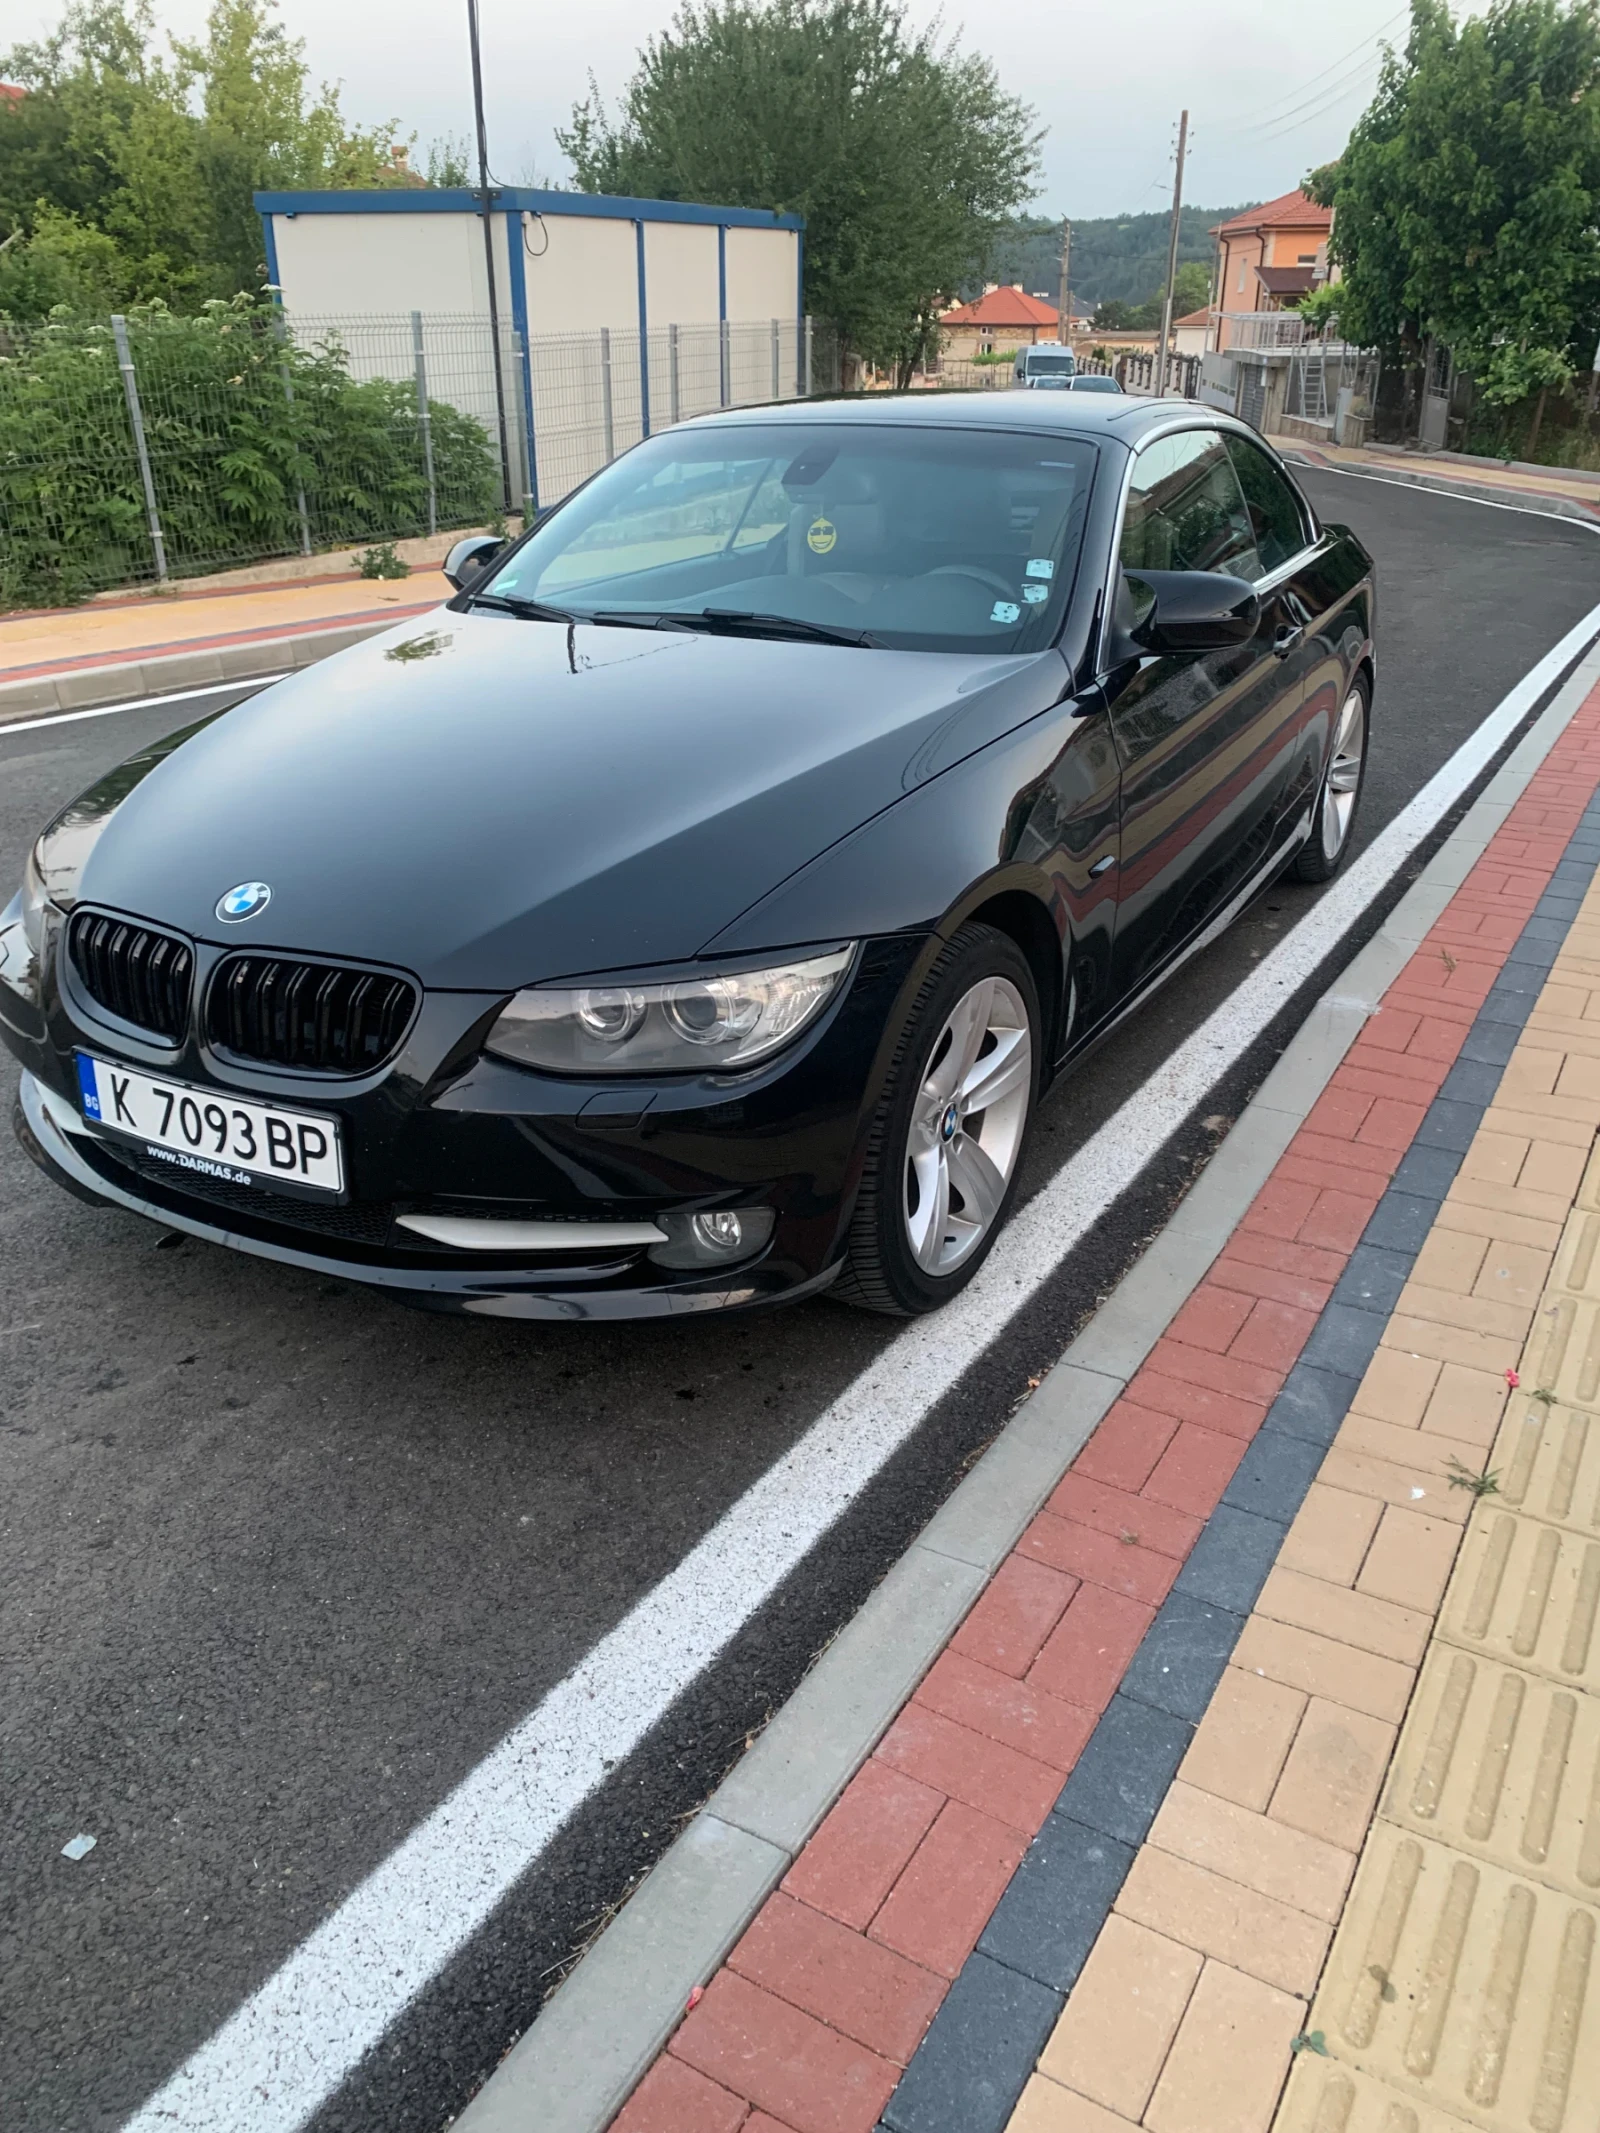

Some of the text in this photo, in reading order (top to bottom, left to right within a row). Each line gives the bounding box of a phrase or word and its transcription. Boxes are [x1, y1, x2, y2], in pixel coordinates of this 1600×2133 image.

[84, 1092, 99, 1111] BG
[110, 1073, 137, 1128] K
[146, 1145, 252, 1185] www.DARMAS.de
